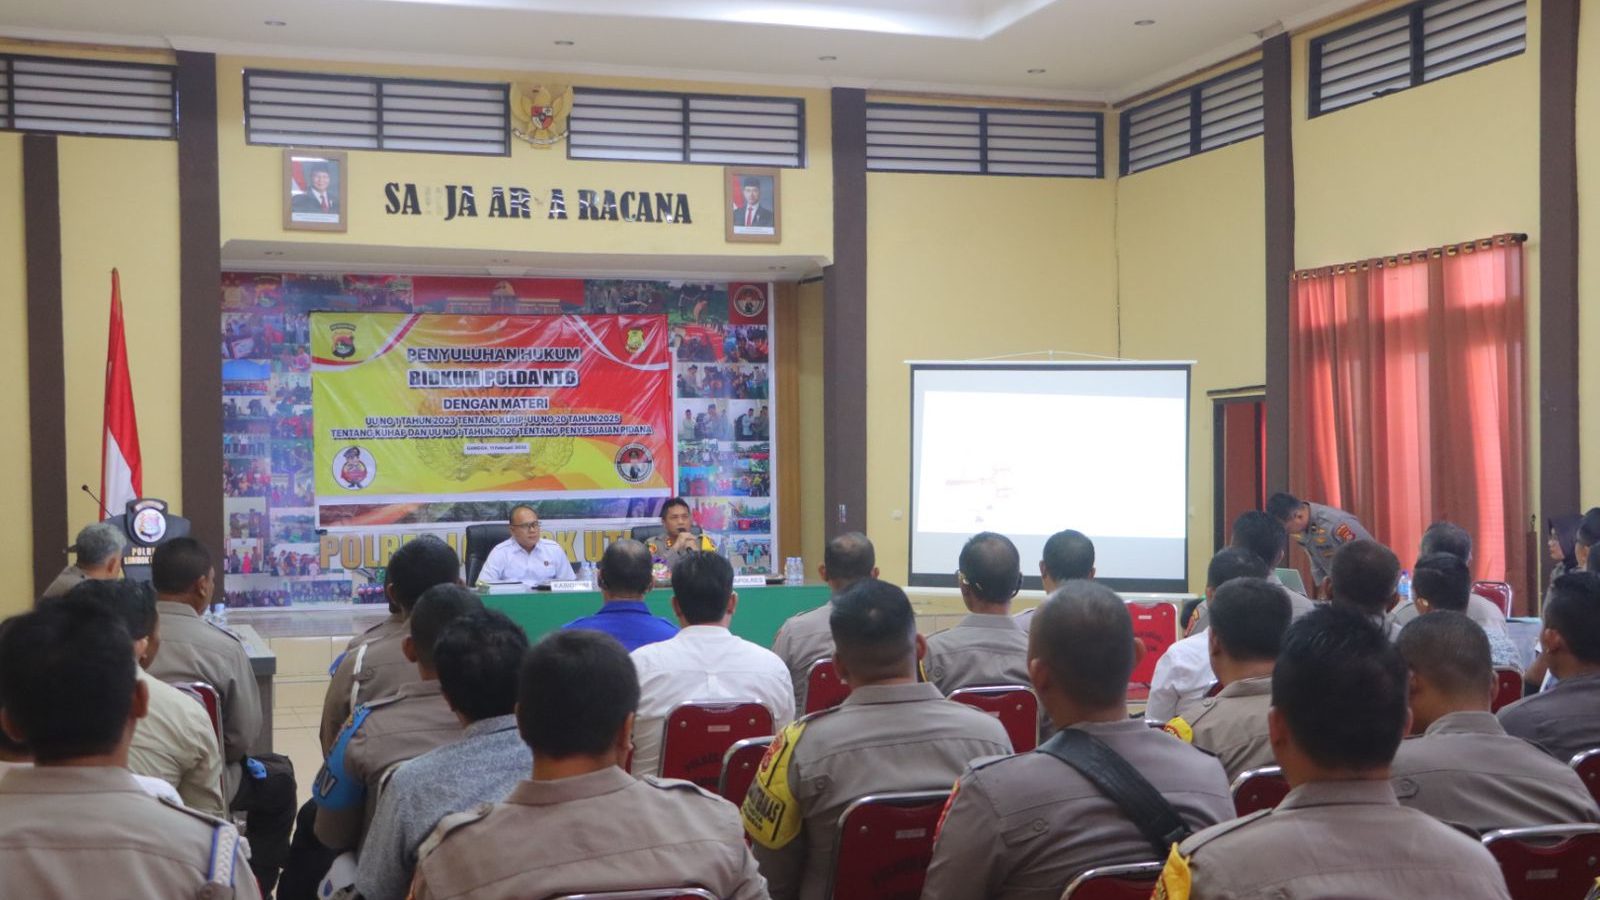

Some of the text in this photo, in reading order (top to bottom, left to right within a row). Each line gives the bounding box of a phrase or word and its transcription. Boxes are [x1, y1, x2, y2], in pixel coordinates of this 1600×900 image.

[385, 182, 693, 225] SAJA ARA RACANA
[407, 348, 580, 361] PENYULUHAN HUKUM
[409, 370, 480, 386] BIDKUM
[485, 370, 538, 386] POLDA
[443, 398, 548, 410] DENGAN MATERI
[401, 416, 432, 425] TAHUN
[457, 416, 497, 425] TENTANG
[568, 415, 597, 423] TAHUN
[331, 429, 372, 438] TENTANG
[408, 429, 427, 437] DAN
[464, 428, 494, 436] TAHUN
[519, 427, 558, 435] TENTANG
[560, 427, 619, 435] PENYESUAIAN
[621, 426, 653, 434] PIDANA
